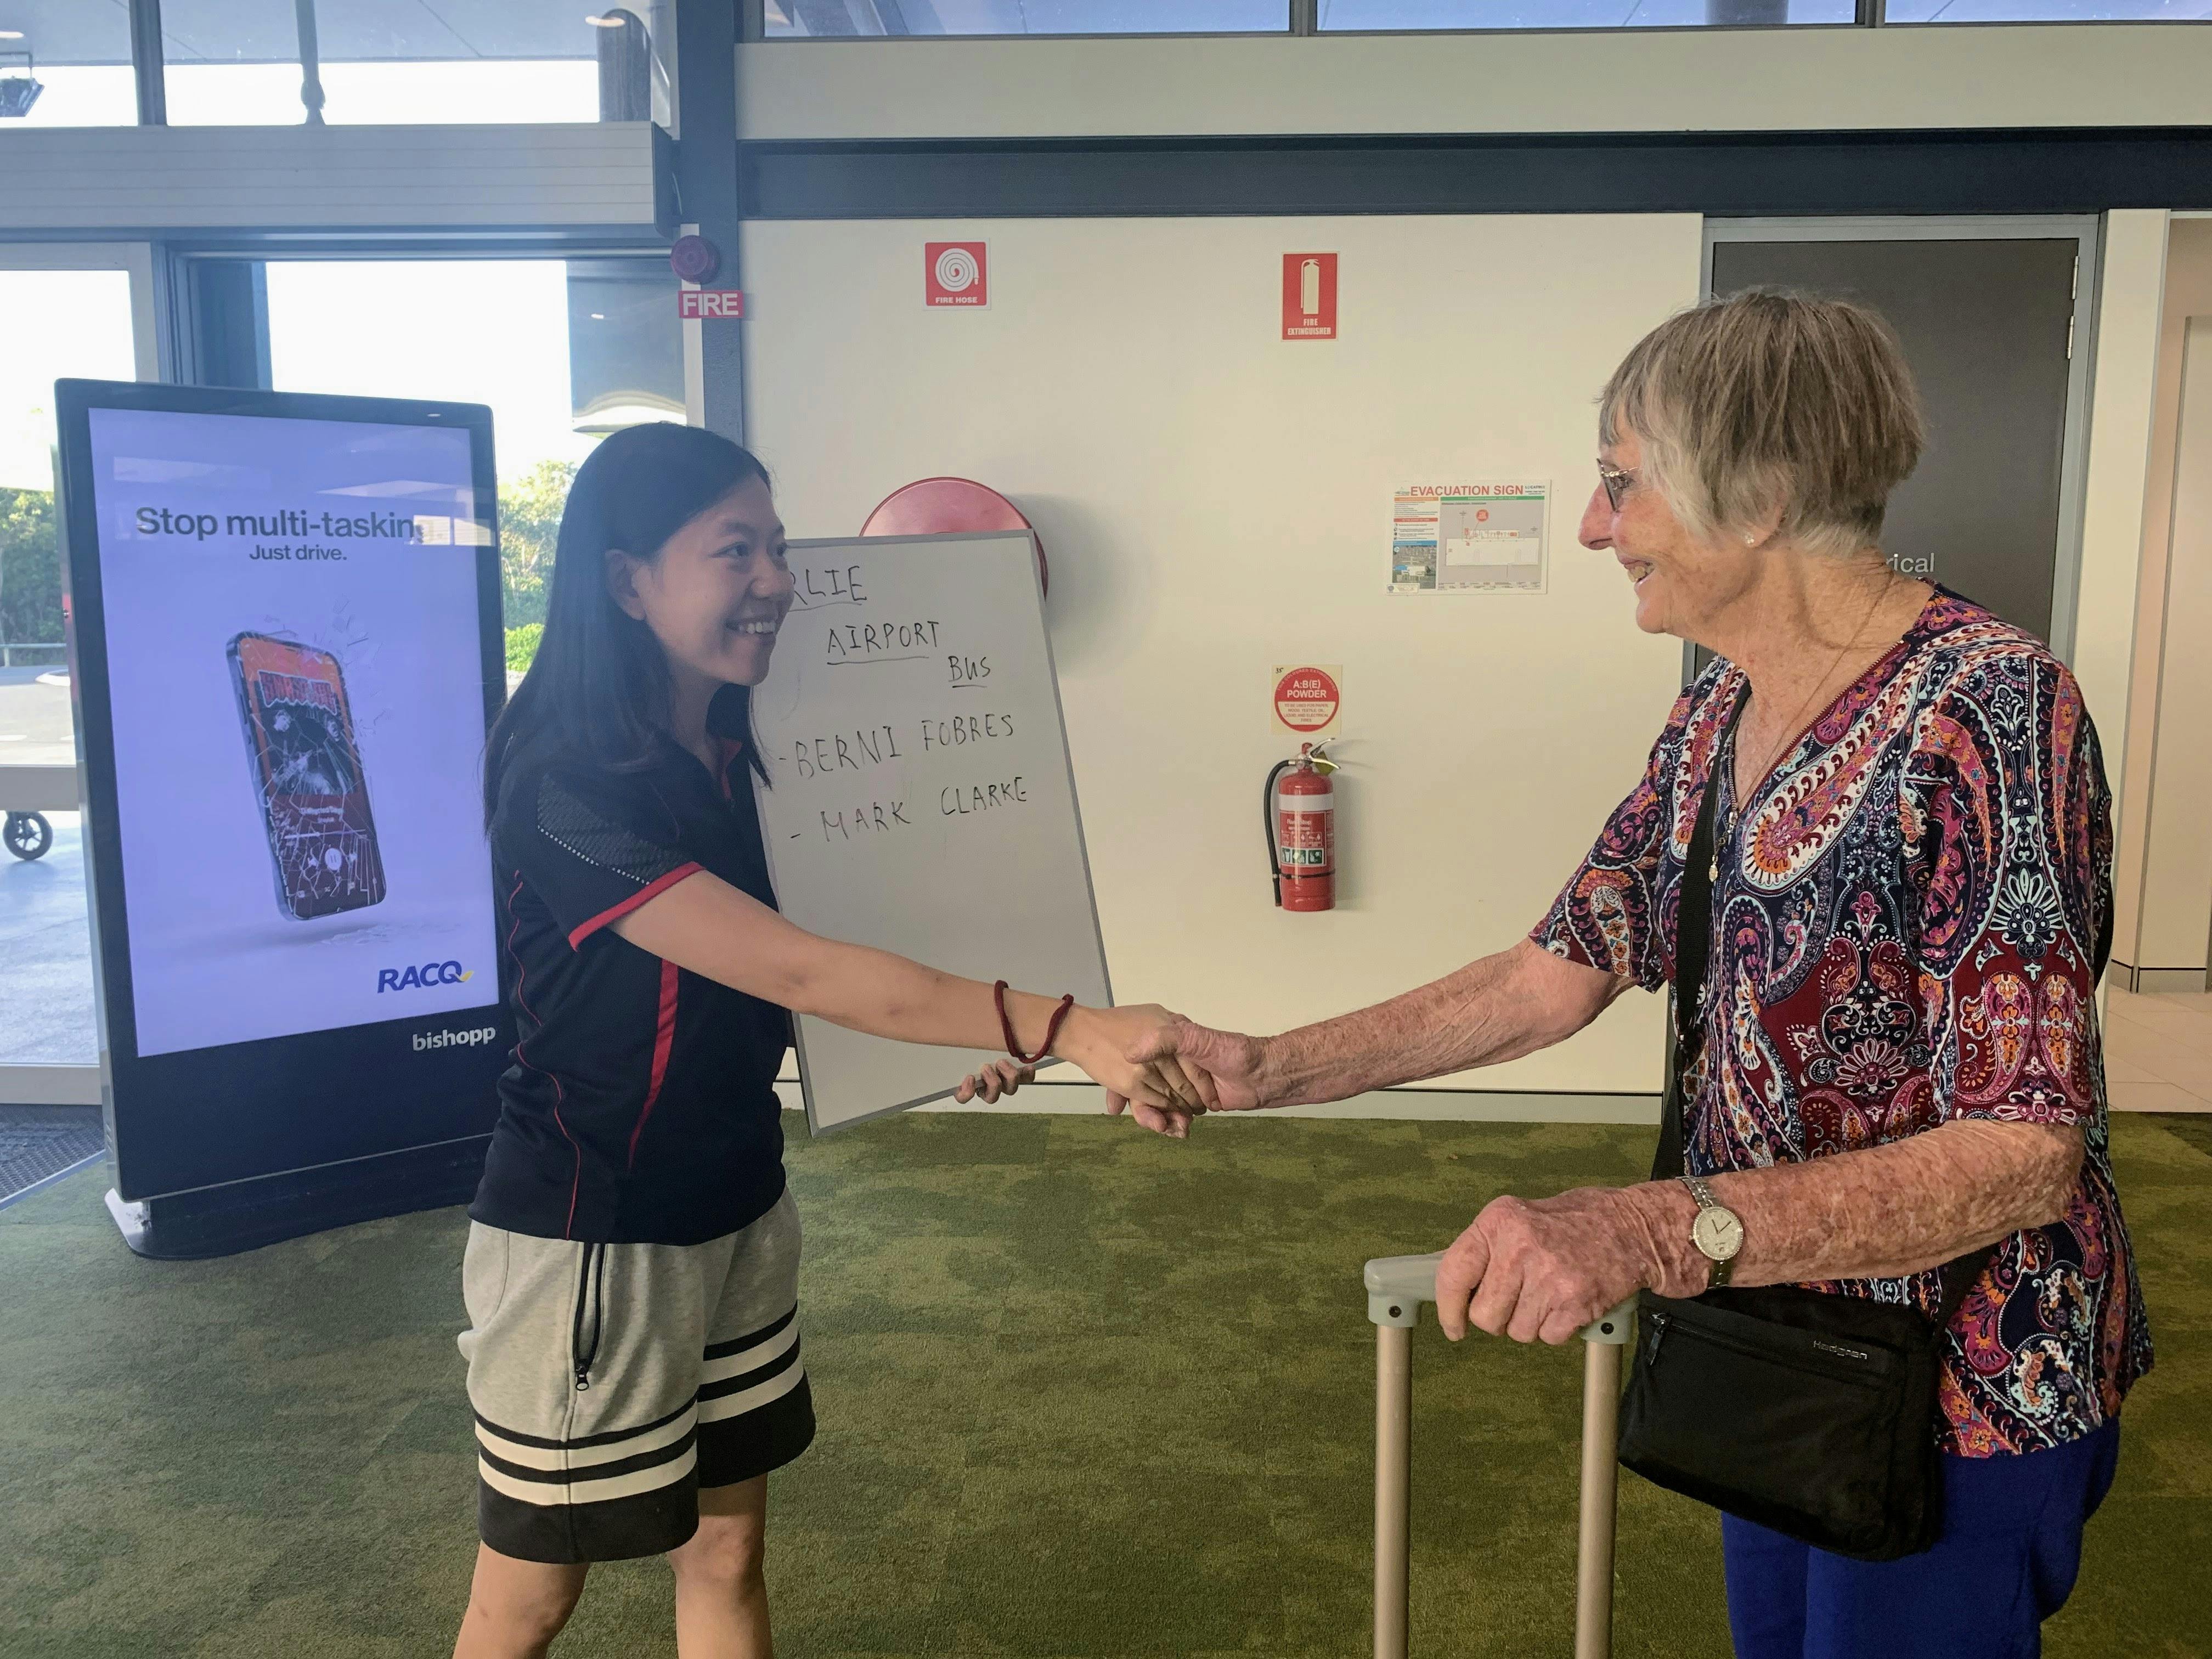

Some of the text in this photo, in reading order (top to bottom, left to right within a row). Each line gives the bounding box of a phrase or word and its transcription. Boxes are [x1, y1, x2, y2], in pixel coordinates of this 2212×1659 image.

[682, 294, 738, 315] FIRE
[1410, 485, 1523, 496] EVACUATION SIGN
[137, 507, 218, 541] Stop
[250, 544, 347, 561] Just drive.
[827, 621, 939, 656] AIRPORT
[1286, 690, 1327, 698] POWDER
[922, 714, 1013, 751] FOBRES
[821, 802, 911, 842] MARK
[941, 777, 1026, 815] CLARKE
[377, 961, 465, 994] RACQ
[413, 1027, 496, 1051] bishopp
